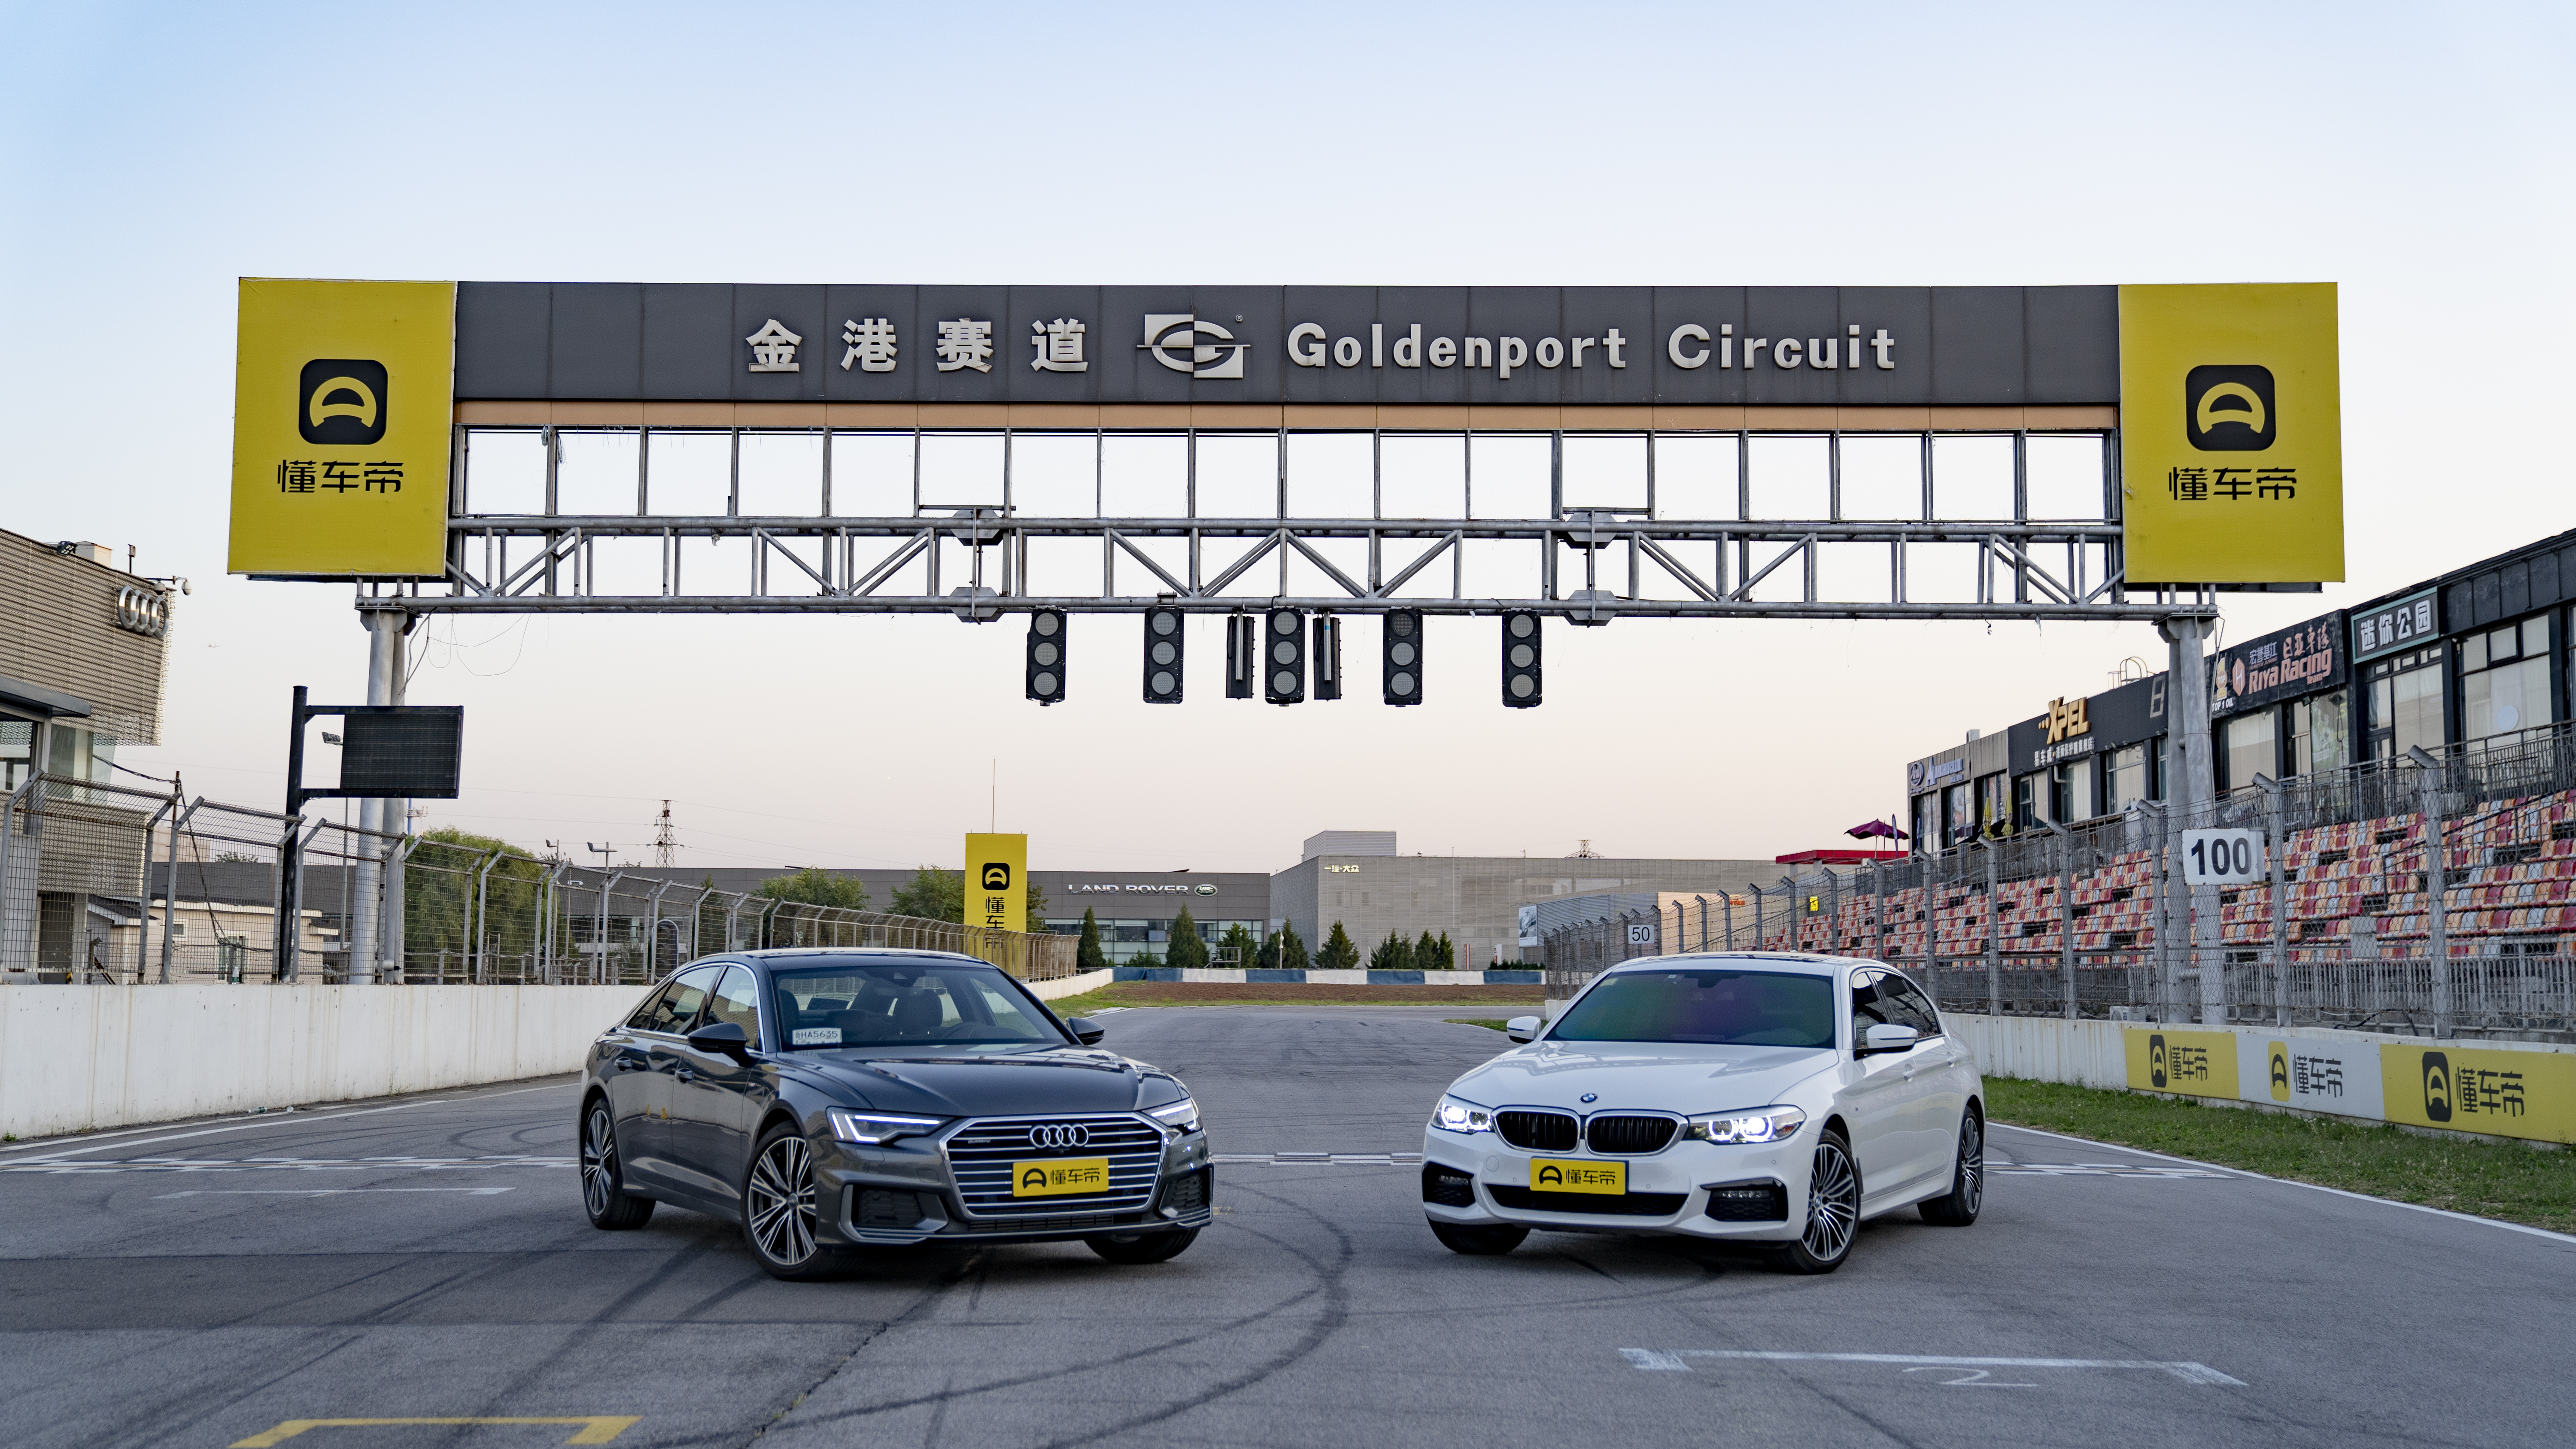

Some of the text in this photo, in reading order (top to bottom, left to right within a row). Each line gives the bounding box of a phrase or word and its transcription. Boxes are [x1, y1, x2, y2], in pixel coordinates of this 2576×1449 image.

[746, 318, 1088, 373] 金港赛道
[1288, 322, 1895, 378] Goldenport Circuit
[277, 459, 404, 493] 懂车帝
[2169, 467, 2297, 500] 懂车帝
[2360, 600, 2432, 652] 迷你公园
[2218, 675, 2226, 685] TOP
[2280, 648, 2333, 684] Racing
[2306, 673, 2323, 685] Team
[2046, 696, 2090, 745] XPEL
[2212, 697, 2234, 712] TOP 1 OIL
[2191, 838, 2251, 875] 100
[1068, 884, 1189, 894] LAND ROVER
[1632, 927, 1650, 941] 50
[2169, 1045, 2208, 1082] 懂车帝
[2293, 1054, 2343, 1098] 懂车帝
[2455, 1066, 2524, 1117] 懂车帝
[1051, 1167, 1100, 1185] 懂车帝
[1566, 1168, 1616, 1185] 懂车帝
